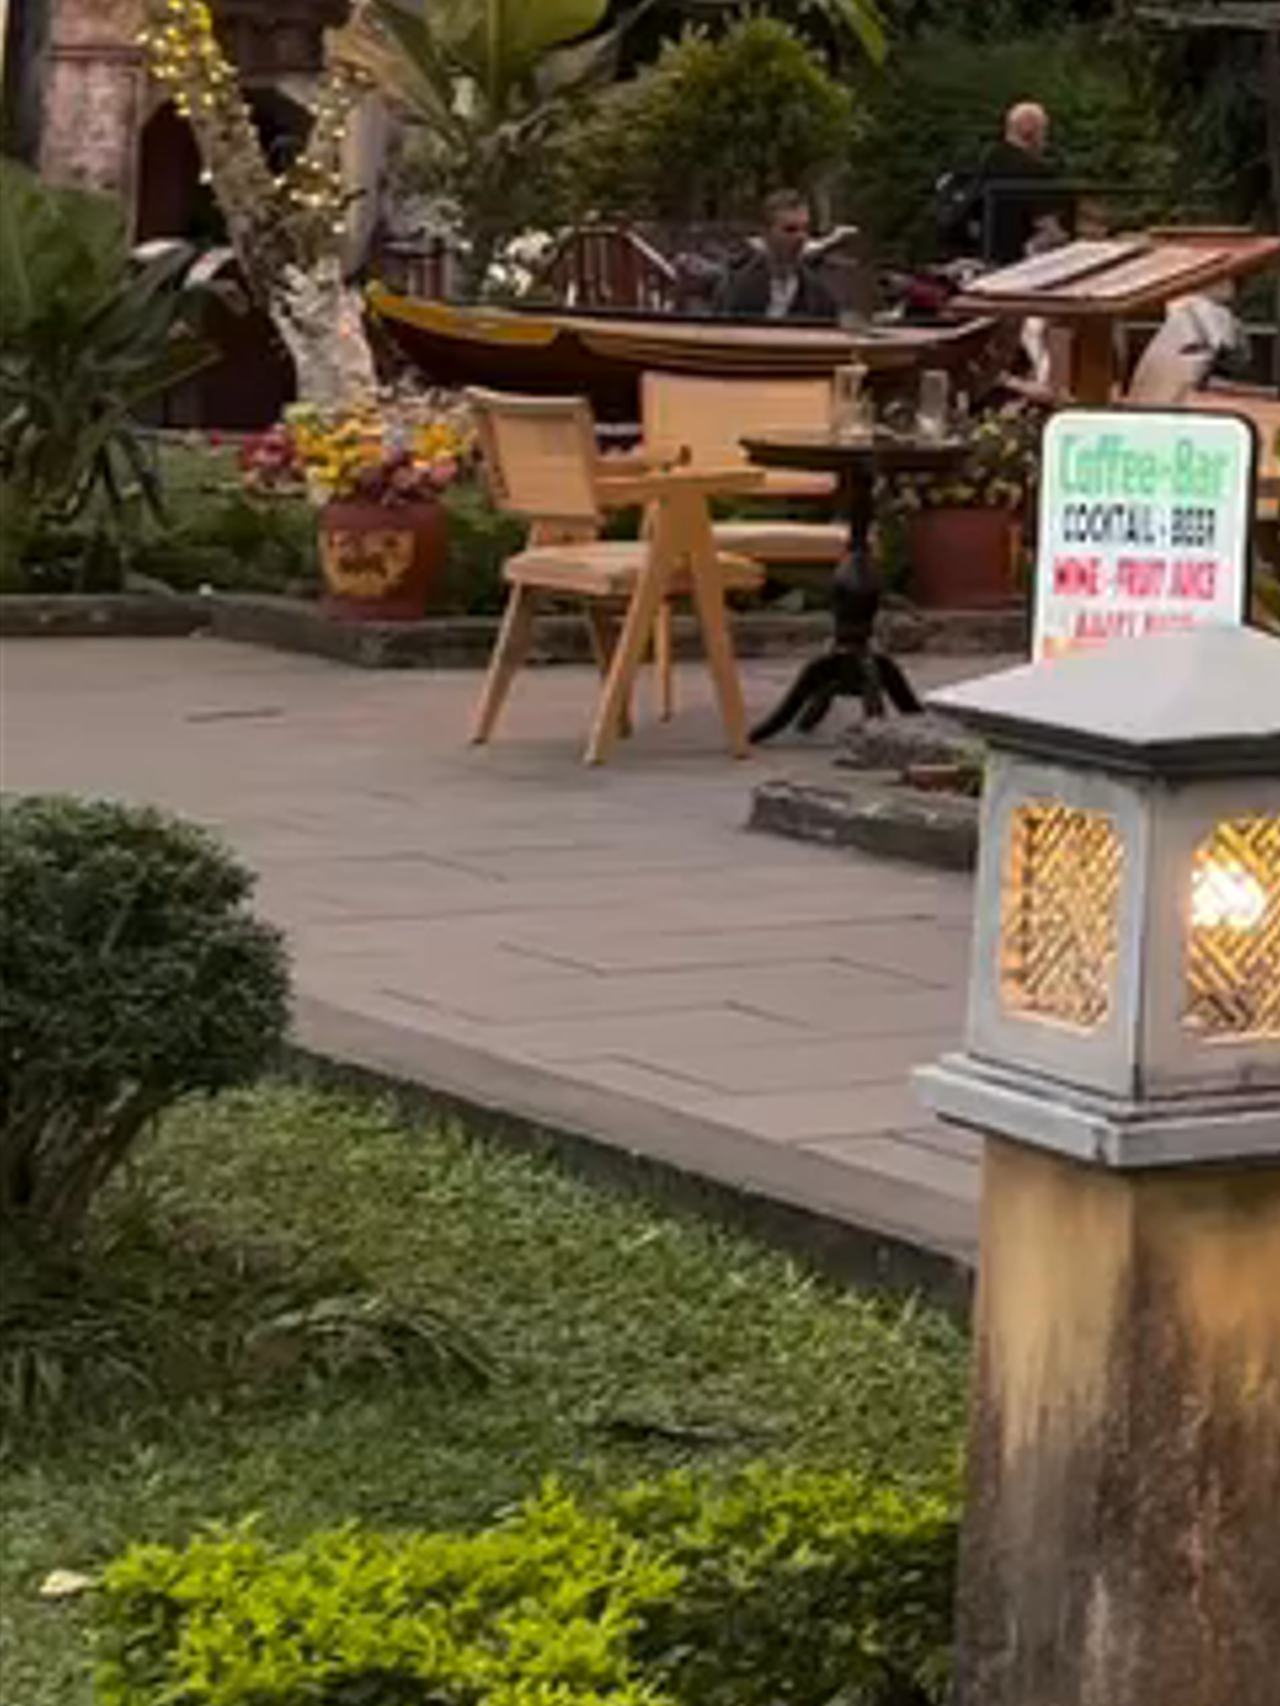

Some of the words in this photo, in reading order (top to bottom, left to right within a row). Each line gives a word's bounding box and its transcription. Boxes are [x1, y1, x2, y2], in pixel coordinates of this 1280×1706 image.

[1063, 503, 1155, 543] COCKTAIL
[1171, 506, 1215, 546] BEER
[1053, 557, 1099, 595] WINE
[1117, 559, 1166, 597] FRUIT
[1168, 560, 1215, 600] JUICE
